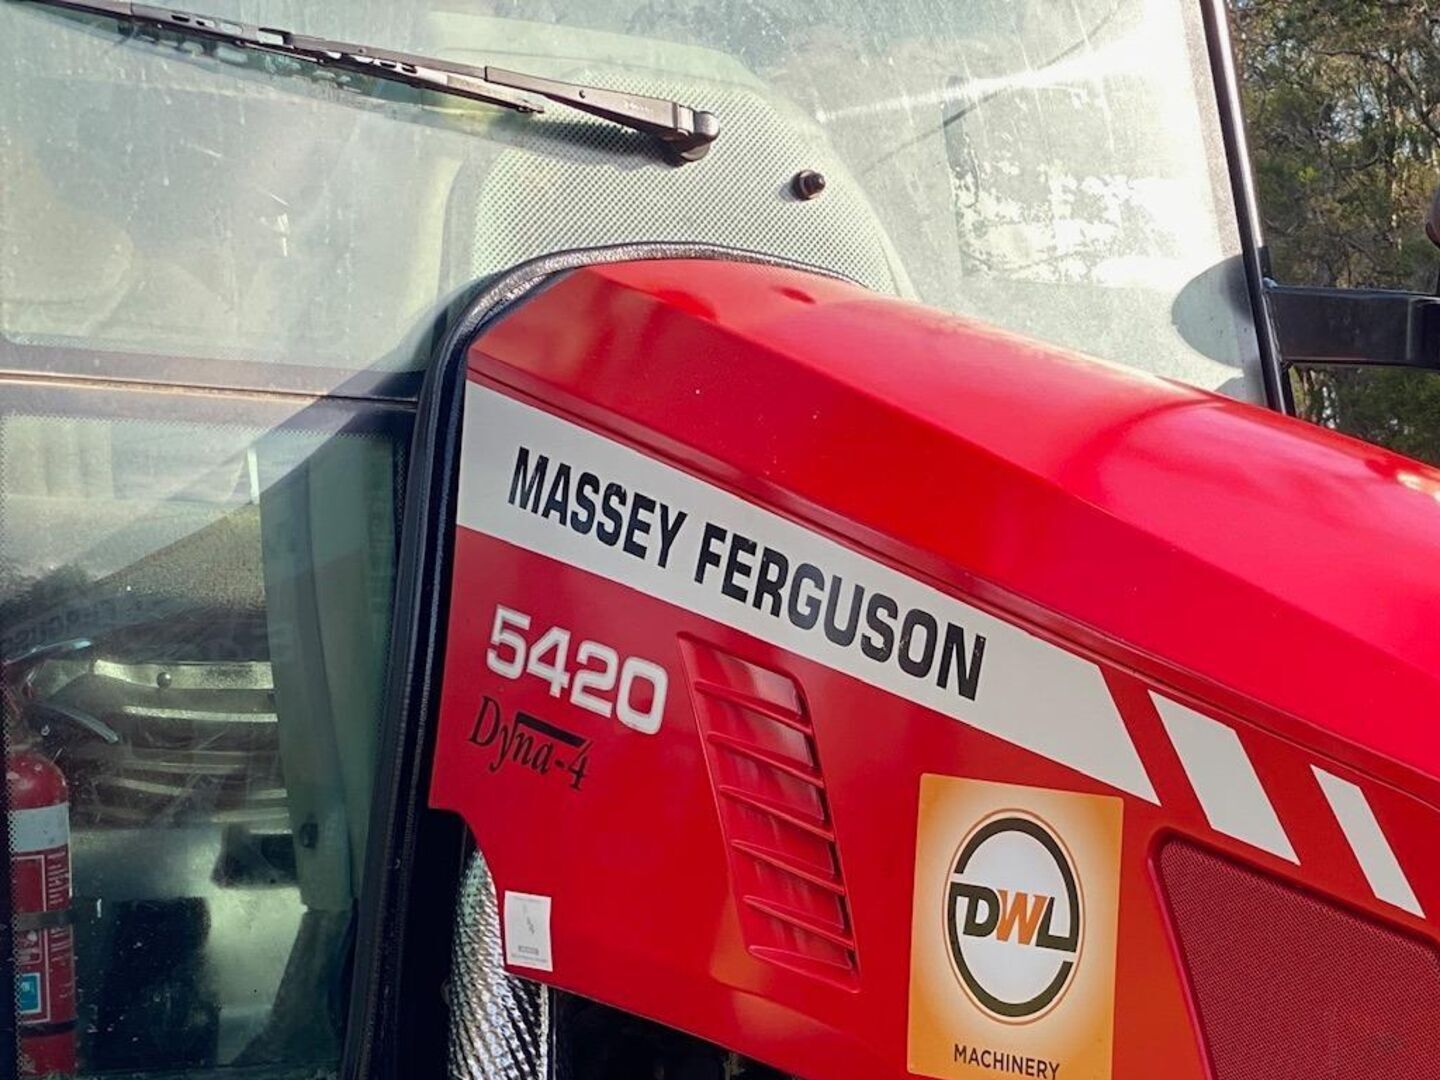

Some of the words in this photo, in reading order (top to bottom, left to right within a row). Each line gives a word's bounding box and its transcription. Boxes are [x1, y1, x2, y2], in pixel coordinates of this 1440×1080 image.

[508, 446, 688, 568] MASSEY
[694, 522, 987, 702] FERGUSON
[485, 605, 669, 735] 5420
[467, 695, 592, 791] Dyna-4
[949, 881, 1078, 953] DWL
[953, 1043, 1060, 1080] MACHINERY
